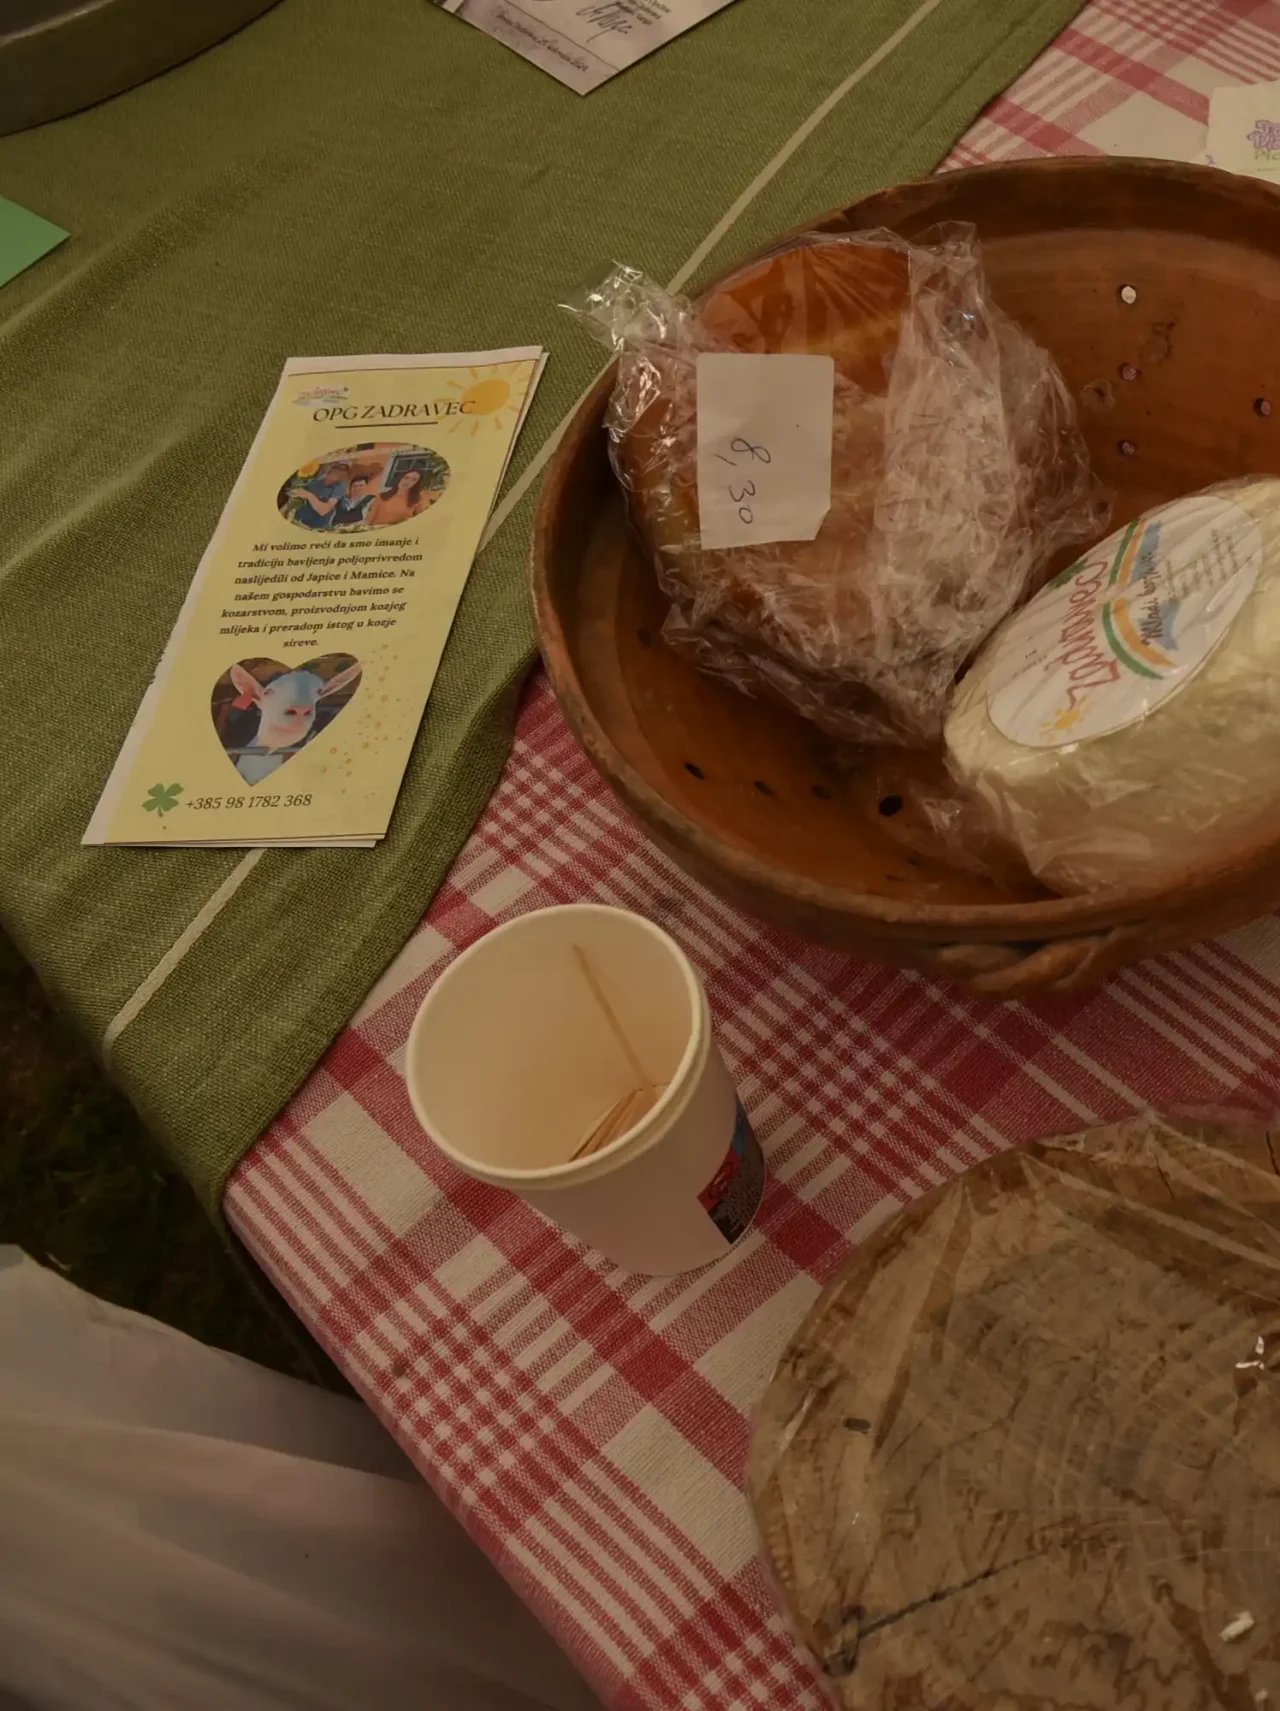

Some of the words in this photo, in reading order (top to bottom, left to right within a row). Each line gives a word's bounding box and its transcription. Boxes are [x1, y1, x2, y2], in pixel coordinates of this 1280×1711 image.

[313, 406, 358, 422] OPG
[361, 400, 476, 419] ZADRAVEC
[253, 543, 267, 552] Mi
[271, 541, 307, 551] volimo
[309, 540, 331, 550] reći
[333, 539, 347, 549] da
[349, 539, 372, 548] smo
[374, 538, 413, 549] imanje
[238, 558, 284, 570] tradiciju
[287, 555, 335, 568] bavljenja
[337, 553, 423, 567] poljoprivredom
[234, 573, 288, 586] naslijedili
[290, 573, 304, 583] od
[306, 571, 341, 583] Japice
[350, 569, 396, 581] Mamice.
[399, 568, 415, 578] Na
[234, 591, 270, 601] našem
[272, 588, 346, 602] gospodarstvu
[349, 586, 389, 596] bavimo
[391, 585, 405, 594] se
[221, 608, 288, 619] kozarstvom,
[291, 603, 367, 617] proizvodnjom
[370, 601, 407, 612] kozjeg
[219, 624, 260, 636] mlijeka
[268, 622, 323, 635] preradom
[326, 619, 355, 631] istog
[357, 620, 364, 628] u
[367, 617, 397, 629] kozje
[283, 638, 319, 648] sireve.
[186, 797, 223, 810] +385
[225, 796, 245, 809] 98
[248, 795, 281, 808] 1782
[283, 793, 312, 807] 368
